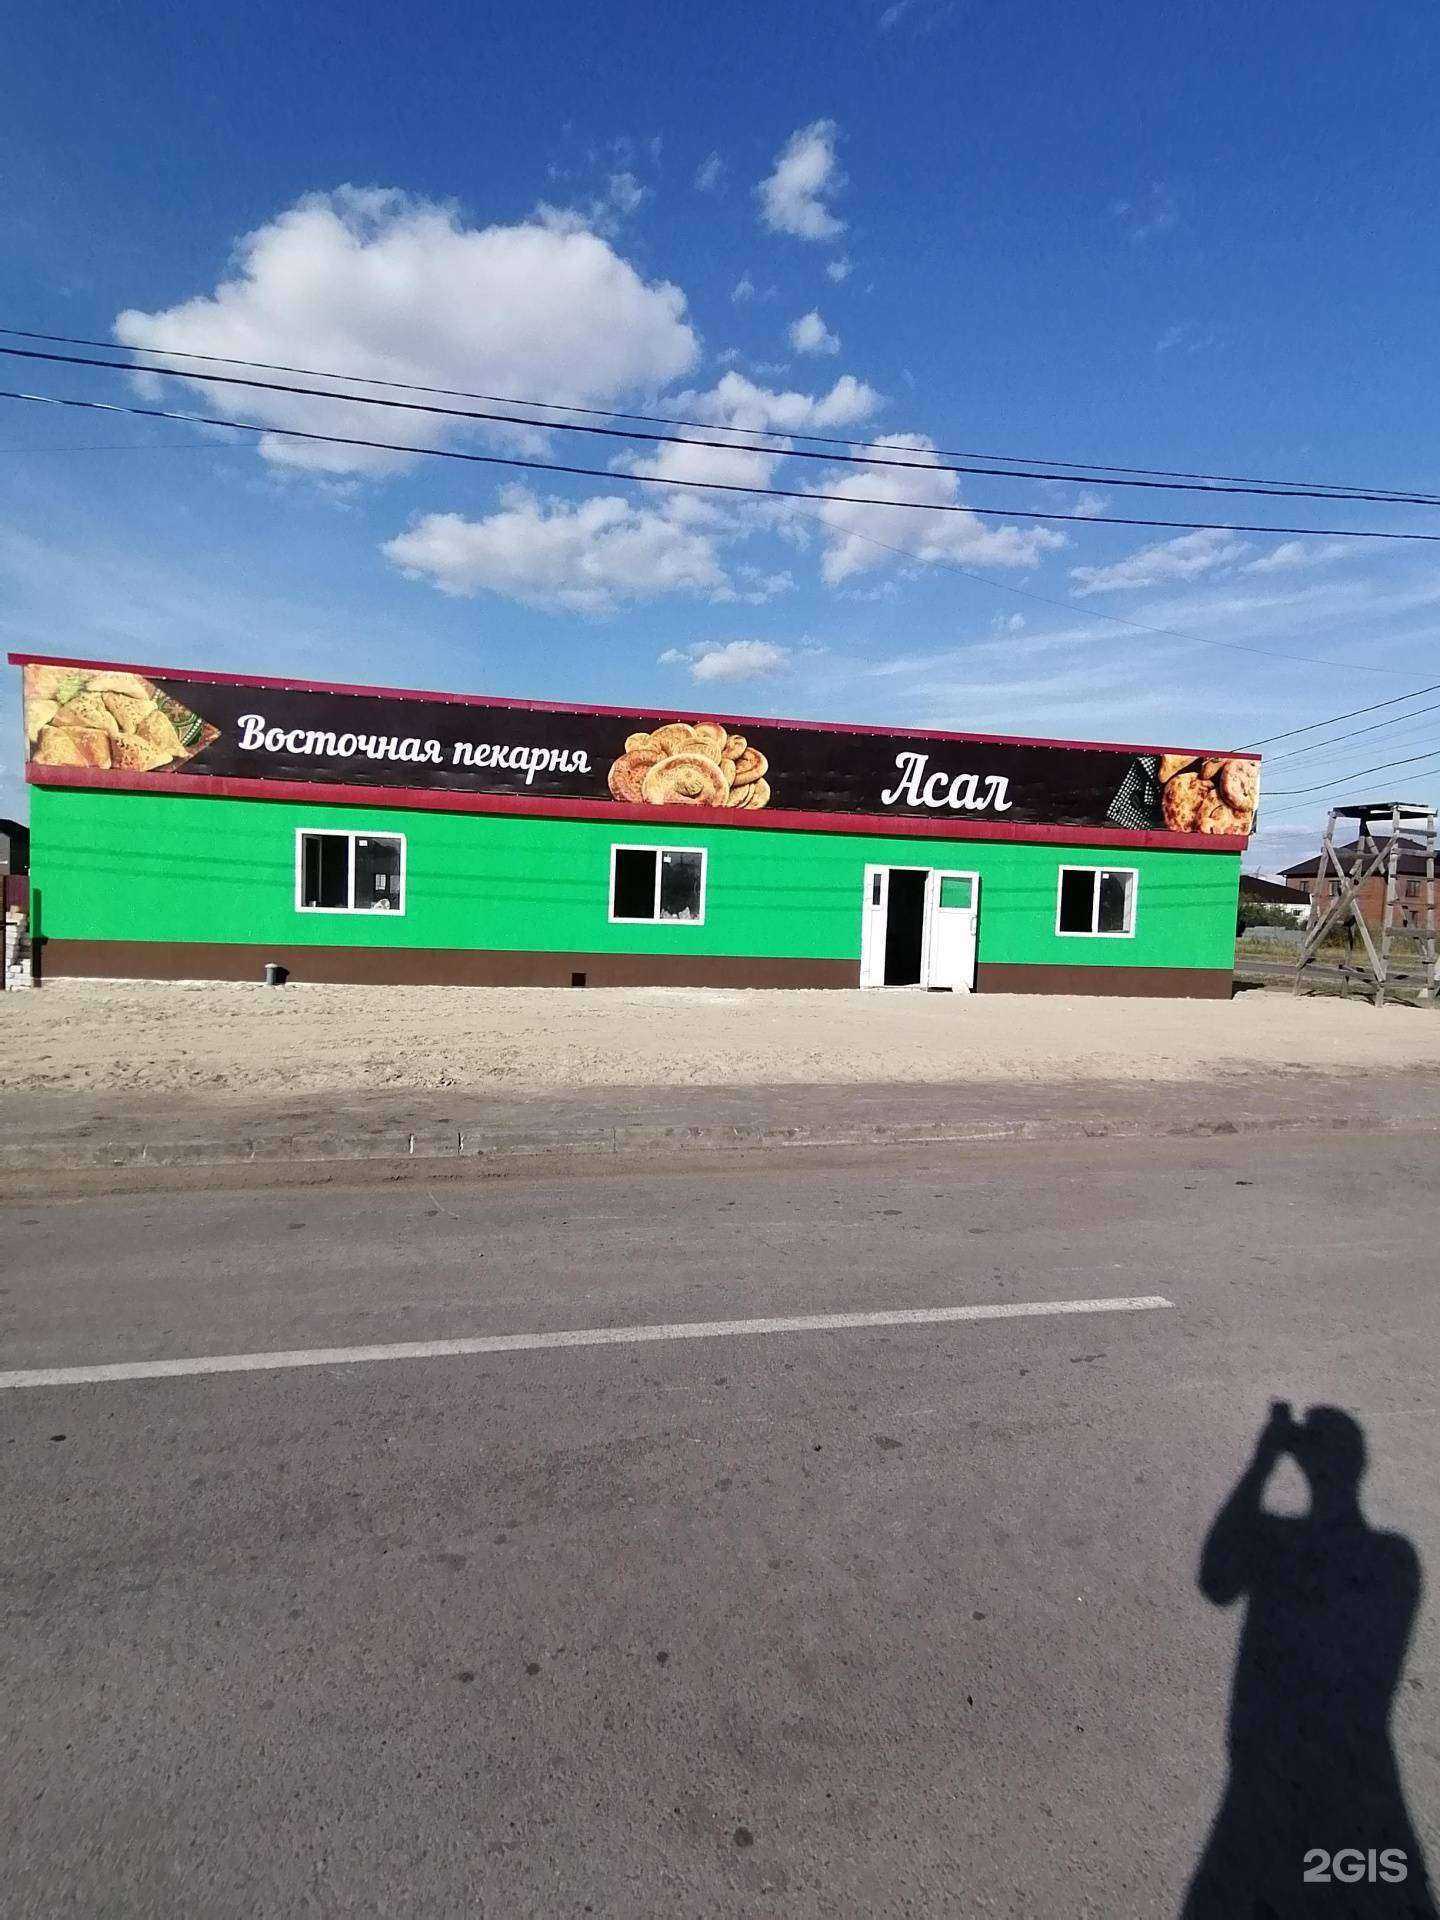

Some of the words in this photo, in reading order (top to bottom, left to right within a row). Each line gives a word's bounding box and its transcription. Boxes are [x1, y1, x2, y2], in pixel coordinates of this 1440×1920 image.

[237, 713, 444, 764] Восточная
[452, 741, 592, 785] пекарня
[880, 751, 1013, 812] Асал
